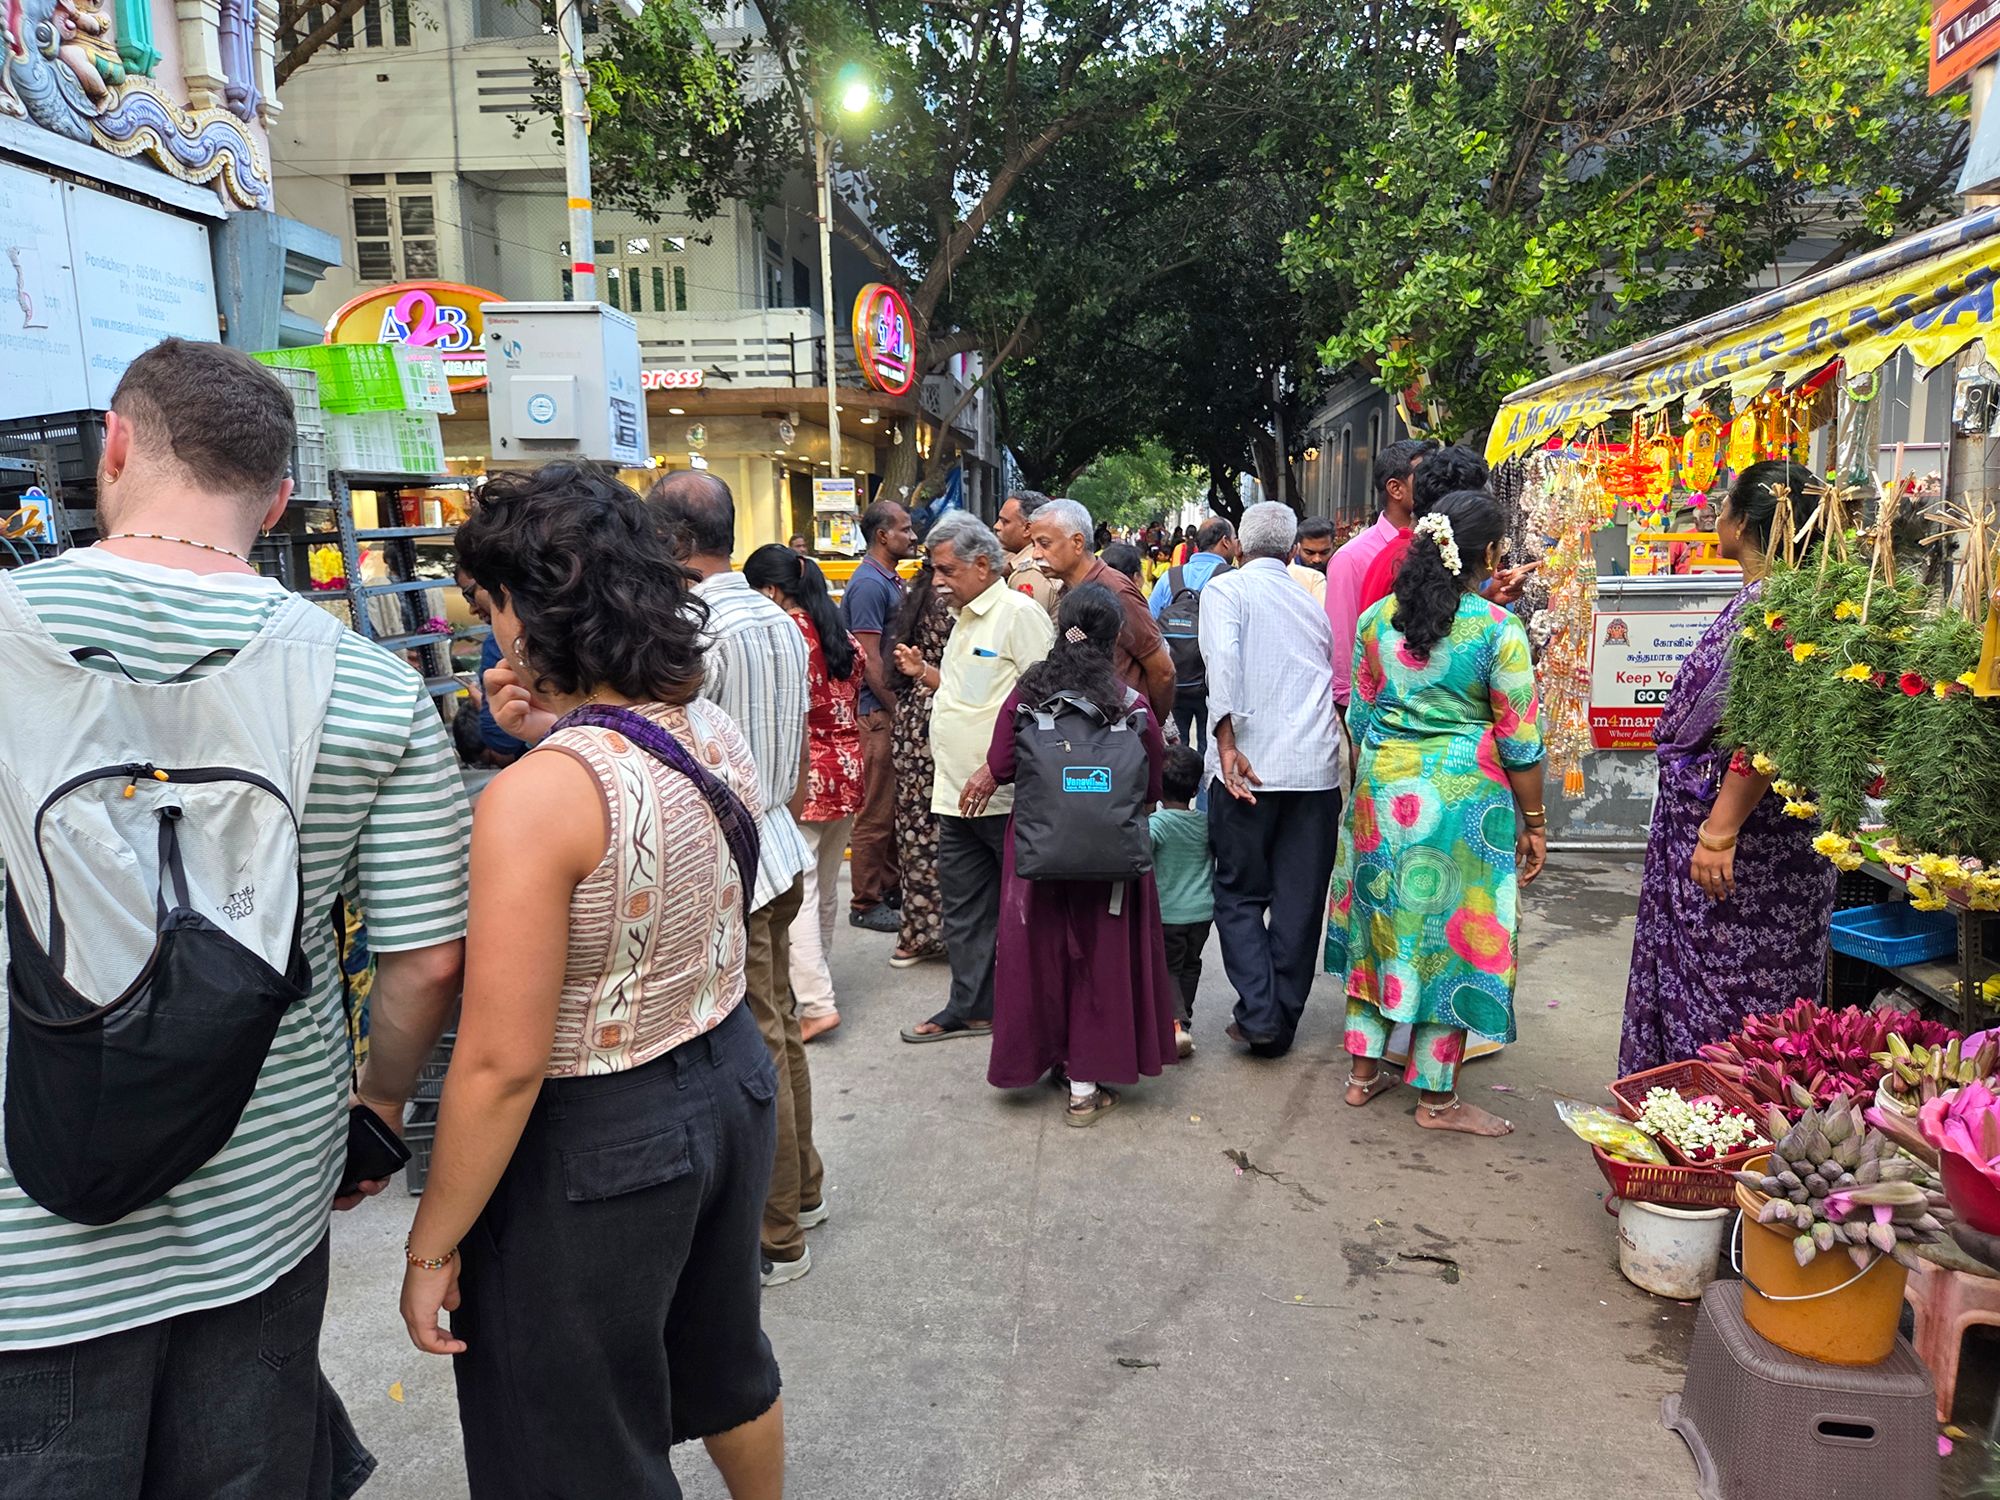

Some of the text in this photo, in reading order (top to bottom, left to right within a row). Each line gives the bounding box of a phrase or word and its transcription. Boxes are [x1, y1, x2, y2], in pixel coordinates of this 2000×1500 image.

[378, 290, 472, 352] A2B
[1616, 671, 1677, 687] Keep Yo
[1637, 691, 1669, 702] GO G
[1609, 729, 1632, 738] Where
[229, 886, 252, 903] THE
